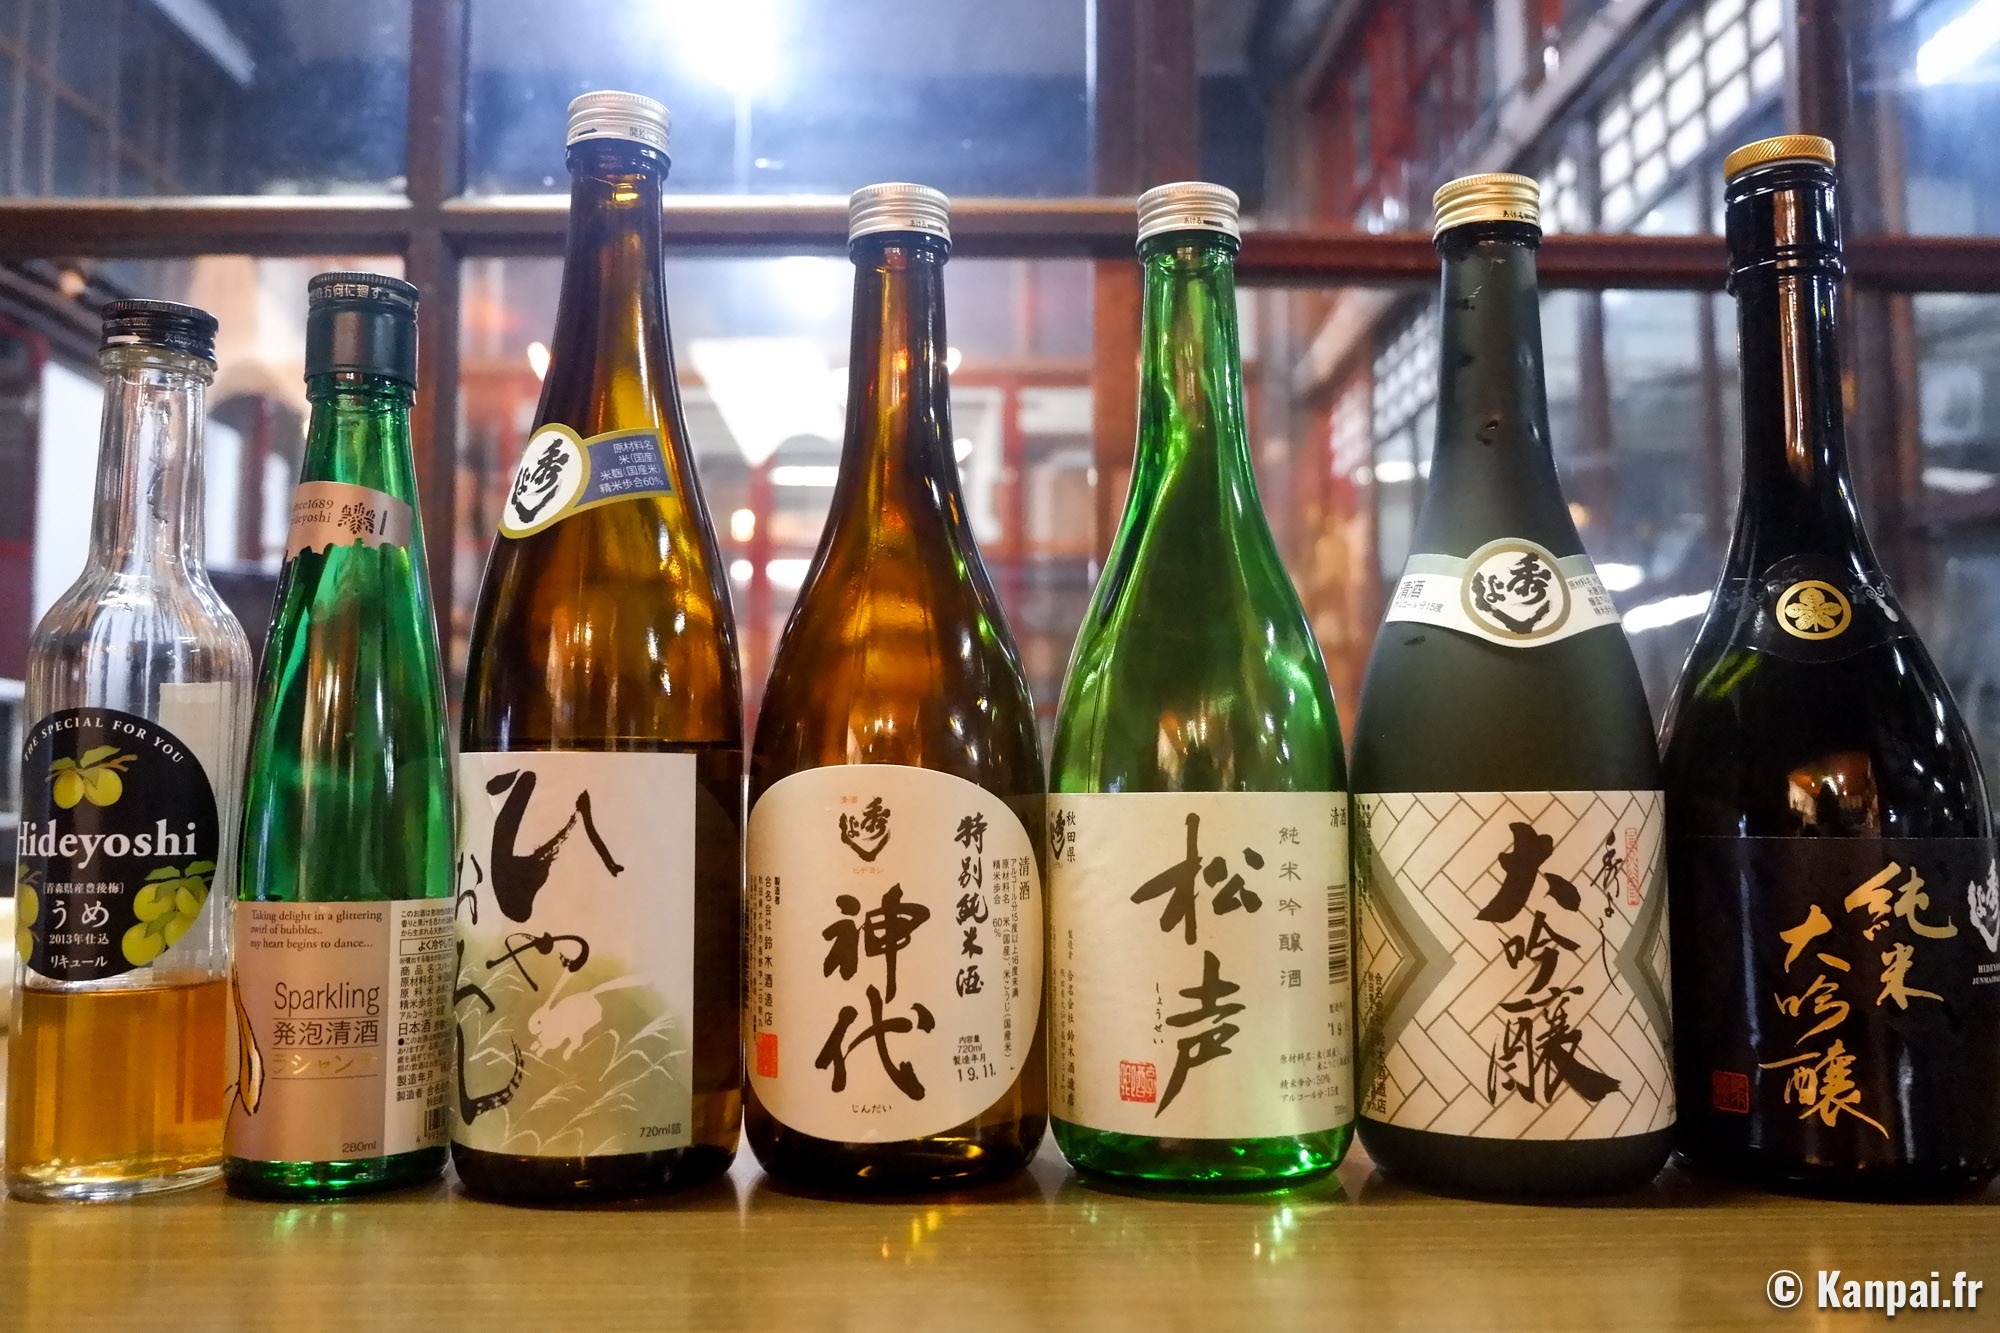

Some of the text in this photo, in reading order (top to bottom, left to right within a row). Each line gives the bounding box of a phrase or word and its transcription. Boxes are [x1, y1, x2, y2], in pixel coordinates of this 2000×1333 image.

[613, 440, 654, 454] 原材料名
[599, 476, 664, 494] 精米歩合60%
[24, 717, 184, 763] THE SPECIAL FOR YOU
[18, 819, 197, 869] Hideyoshi
[1066, 810, 1077, 863] 秋田県
[1019, 856, 1030, 900] 清酒
[52, 900, 110, 930] うめ
[954, 811, 989, 998] 特別純米酒
[1279, 827, 1304, 988] 純米吟醸酒
[252, 909, 277, 923] Taking
[279, 910, 311, 923] delight
[314, 911, 324, 920] in
[336, 909, 383, 922] glittering
[250, 925, 268, 934] swirl
[269, 924, 280, 934] of
[992, 917, 1003, 938] 60%
[1844, 861, 1958, 1010] 純米
[49, 933, 110, 946] 2013年仕込
[250, 940, 261, 950] my
[263, 938, 284, 948] heart
[287, 938, 318, 951] begins
[320, 940, 331, 948] to
[50, 954, 108, 969] リキュール
[1130, 812, 1265, 1119] 松声
[1474, 822, 1622, 1105] 大吟醸
[274, 982, 380, 1016] Sparkling
[815, 882, 936, 1101] 神代
[1153, 982, 1165, 1045] しょうせい
[1758, 904, 1889, 1140] 大吟醸
[273, 1020, 379, 1046] 発泡清酒
[953, 1052, 986, 1066] 製造年月
[957, 1044, 983, 1053] 720ml
[272, 1053, 377, 1075] ラシャン
[397, 1070, 433, 1087] 製造年月
[397, 1089, 423, 1101] 製造者
[852, 1103, 892, 1114] じんだい
[639, 1122, 682, 1139] 720ml詰
[342, 1141, 377, 1153] 280ml
